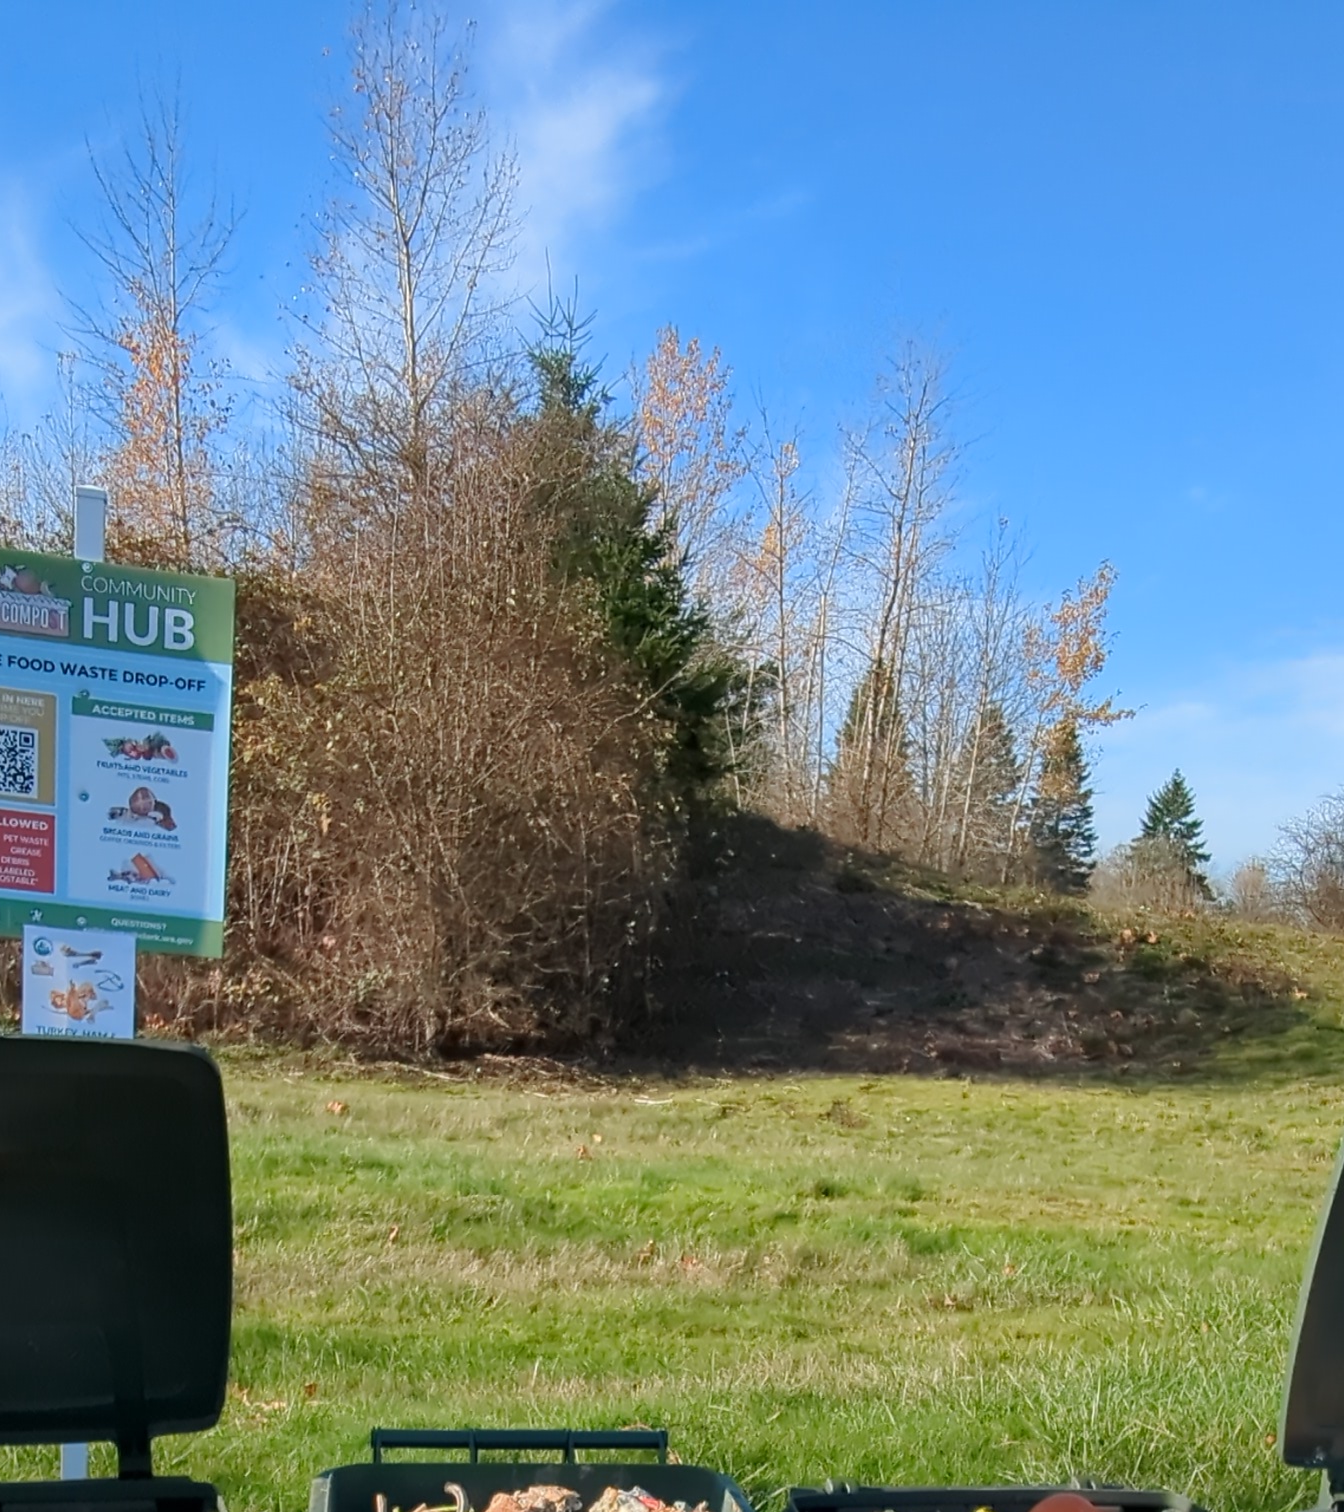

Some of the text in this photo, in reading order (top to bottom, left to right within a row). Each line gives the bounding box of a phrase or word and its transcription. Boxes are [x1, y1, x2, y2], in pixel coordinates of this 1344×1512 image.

[81, 575, 197, 604] COMMUNITY
[1, 602, 64, 631] COMPOST
[83, 597, 195, 650] HUB
[7, 654, 55, 673] FOOD
[60, 662, 118, 682] WASTE
[122, 670, 206, 692] DROP-OFF
[2, 693, 14, 703] IN
[23, 706, 45, 717] YOU
[92, 704, 195, 725] ACCEPTED ITEMS
[97, 760, 123, 770] FRUITS
[142, 765, 188, 778] VEGETABLES
[3, 834, 49, 847] PET WASTE
[134, 831, 150, 839] AND
[10, 846, 42, 857] GREASE
[1, 856, 29, 866] DEBRIS
[0, 866, 35, 877] LABELED
[111, 917, 167, 931] QUESTIONS?
